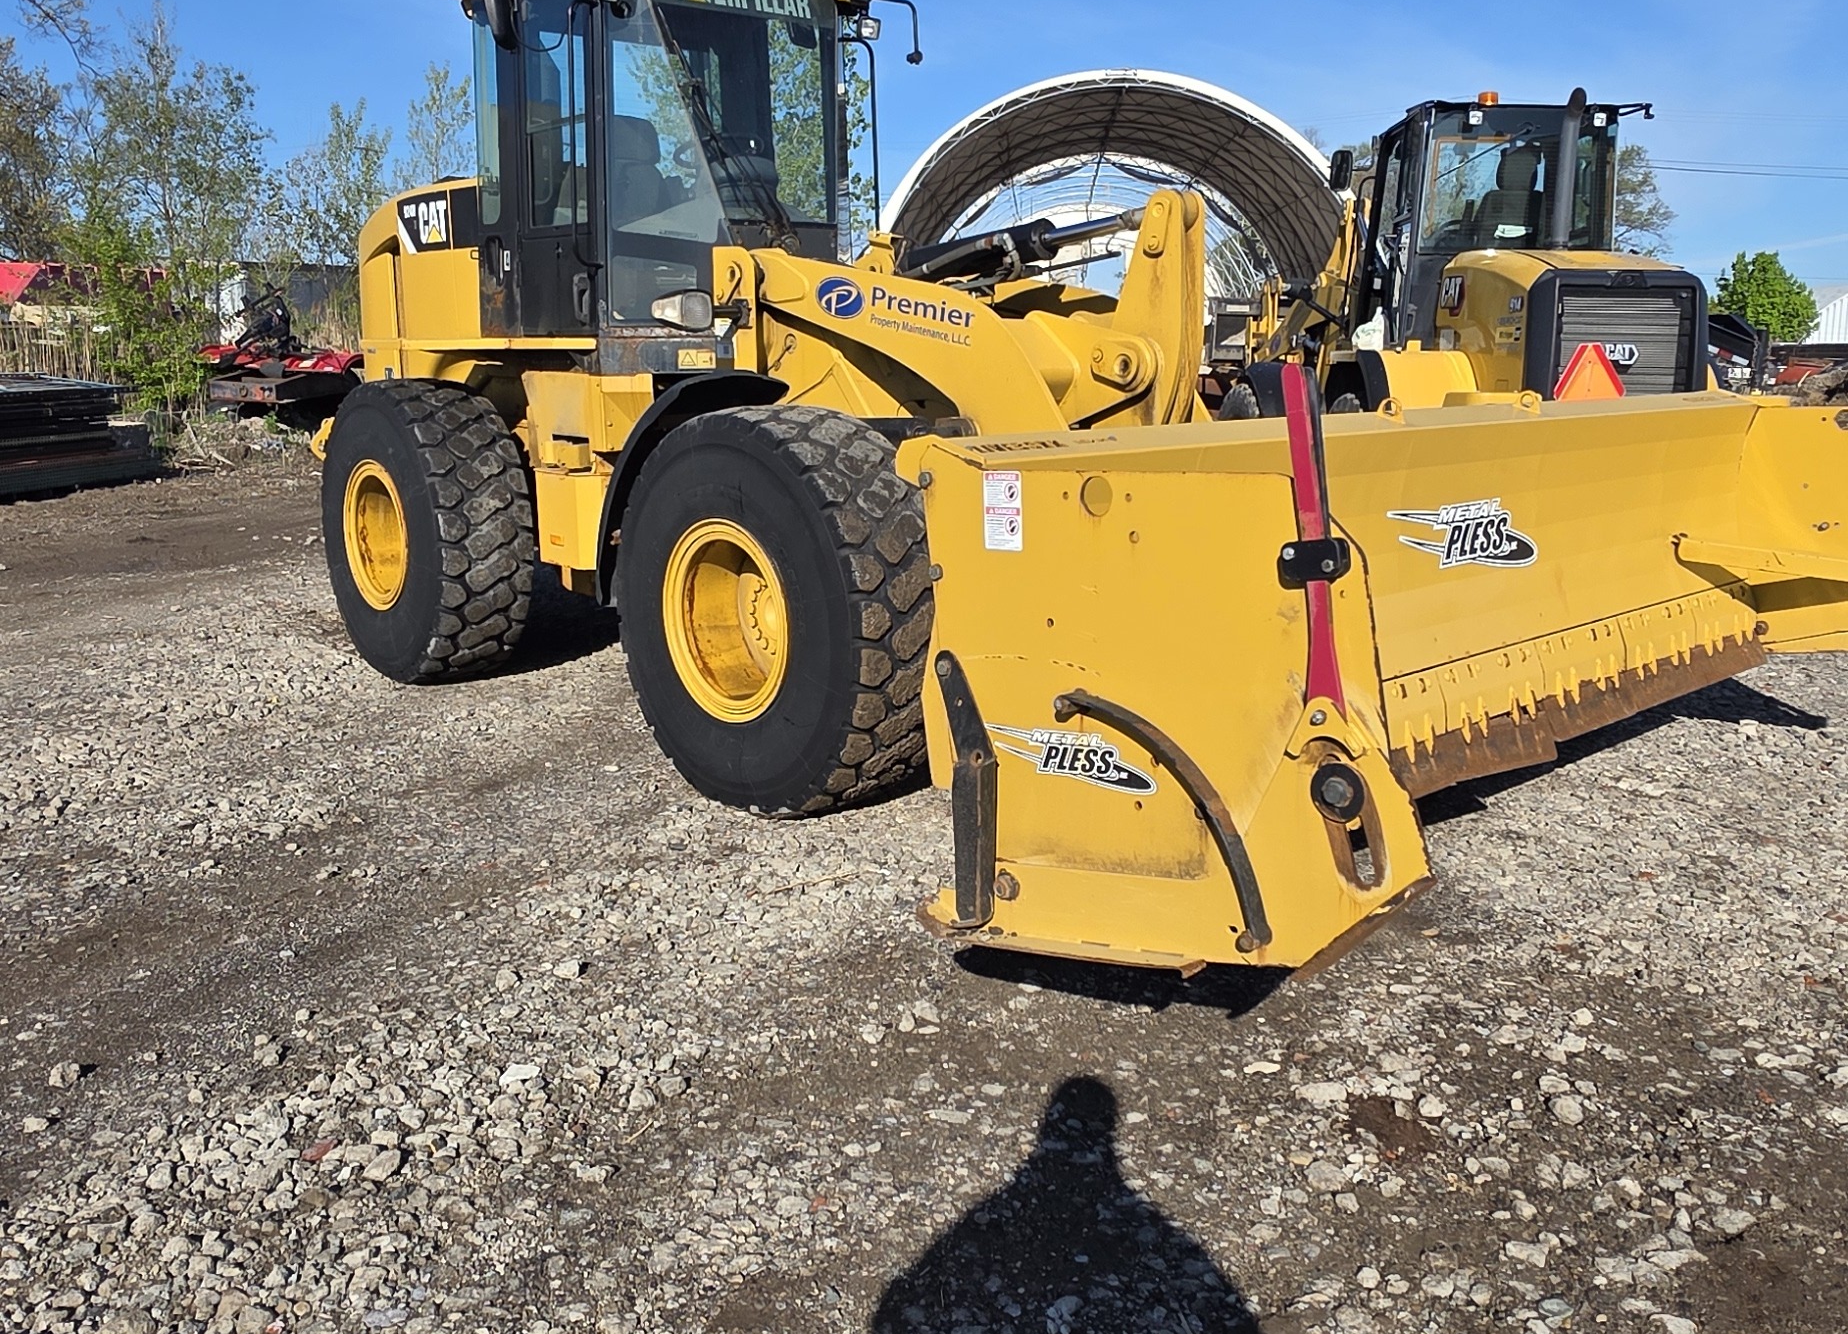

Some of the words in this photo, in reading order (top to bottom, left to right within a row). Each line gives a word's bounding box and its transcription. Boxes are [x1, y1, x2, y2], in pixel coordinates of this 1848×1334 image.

[418, 200, 447, 244] CAT
[871, 286, 975, 328] Premier
[1440, 277, 1463, 308] CAT
[870, 314, 901, 332] Property
[902, 321, 950, 343] Maintenance,
[1605, 344, 1630, 361] CAT
[1437, 499, 1502, 524] METAL
[1445, 516, 1508, 560] PLESS
[1031, 730, 1105, 747] METAL
[1042, 744, 1115, 776] PLESS
